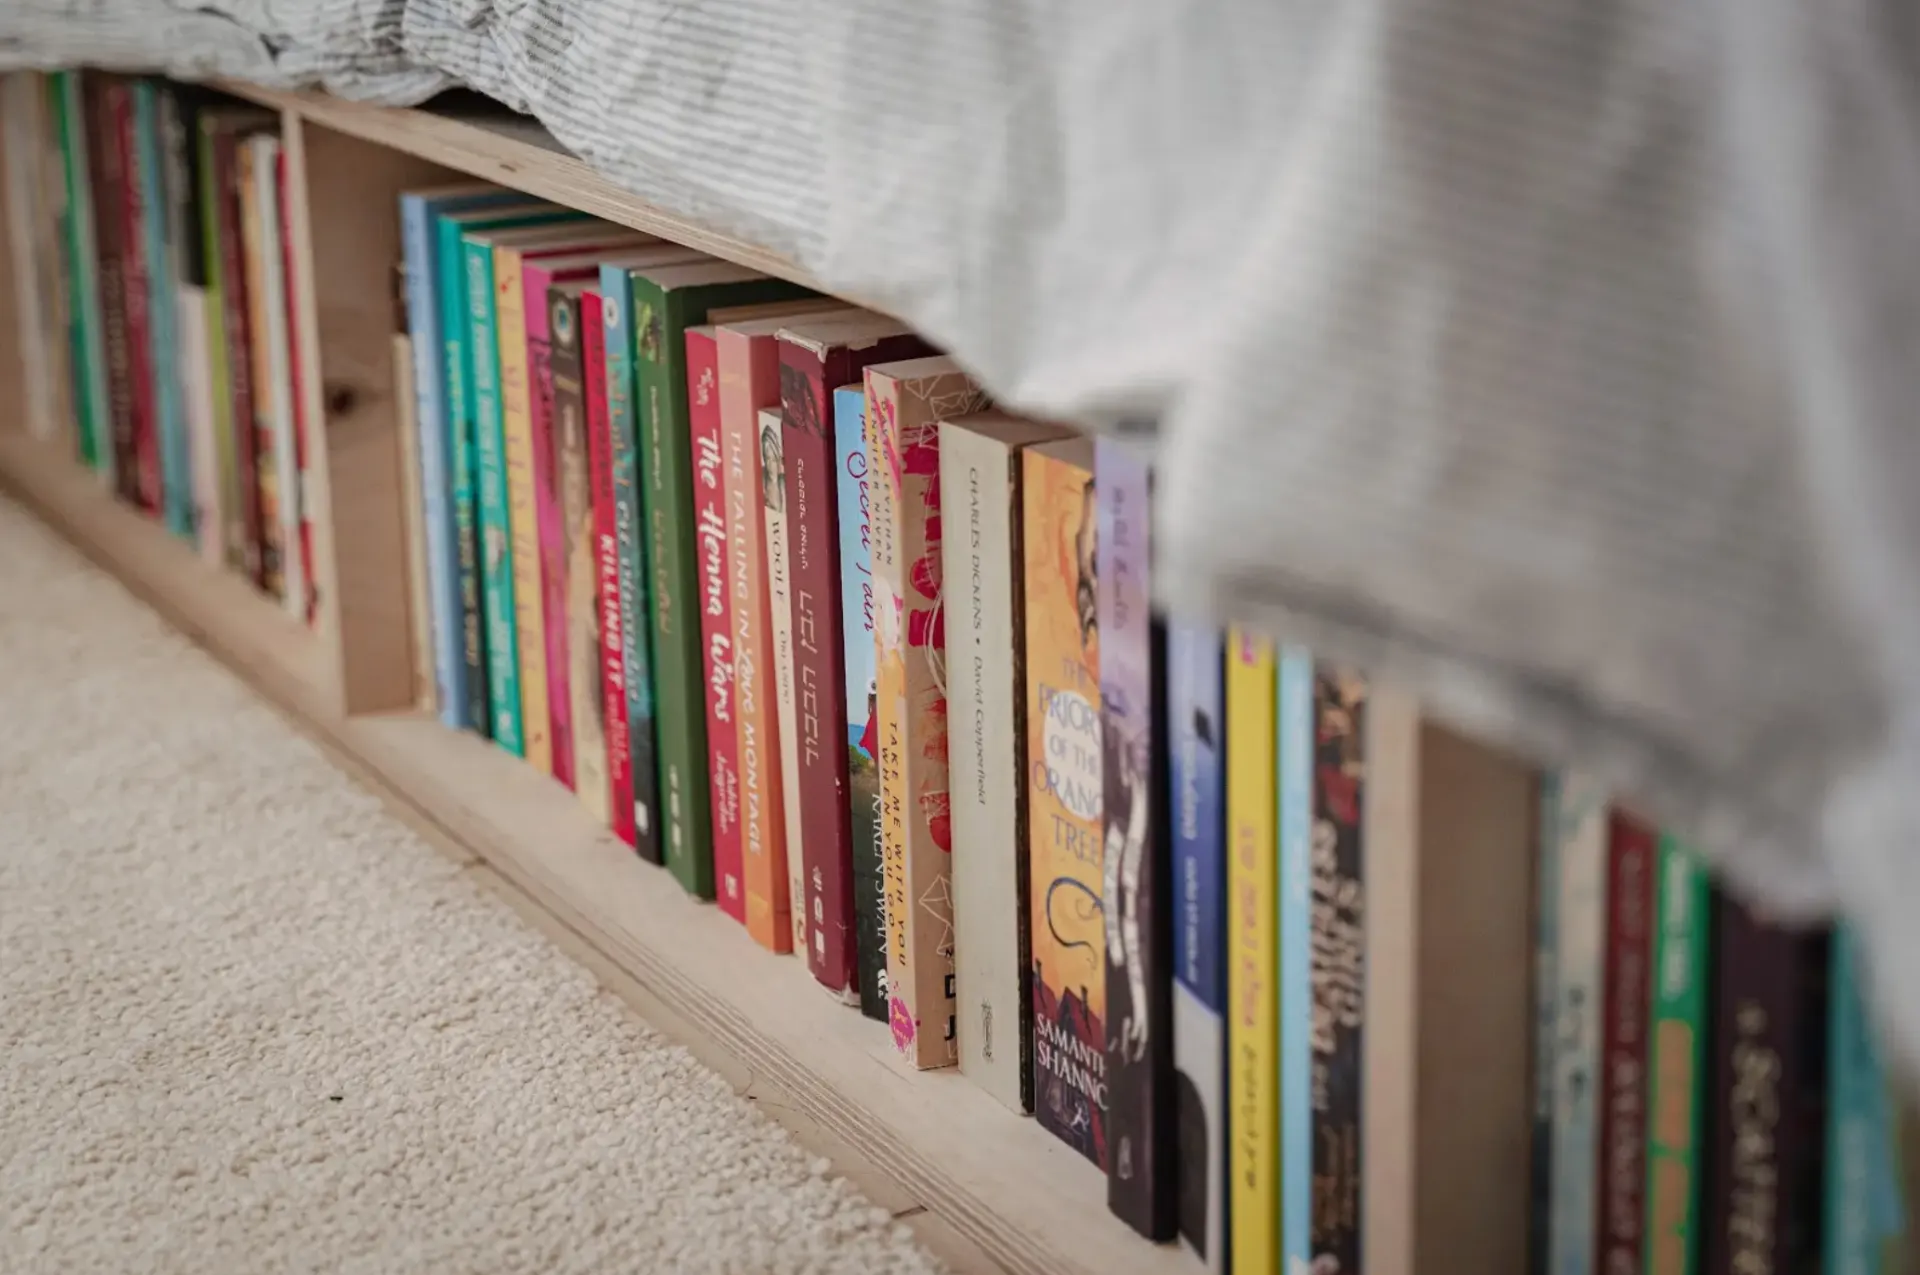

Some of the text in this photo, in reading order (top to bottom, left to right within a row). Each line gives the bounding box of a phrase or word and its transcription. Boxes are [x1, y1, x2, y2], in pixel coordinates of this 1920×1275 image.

[696, 427, 722, 489] The
[729, 431, 744, 480] THE
[869, 396, 882, 561] JENNIFER NIVEN
[700, 501, 727, 616] Henna
[732, 490, 748, 600] FALLING
[771, 520, 783, 603] WOOLF
[882, 471, 892, 565] LEVITHAN
[711, 632, 732, 722] Wars
[738, 609, 751, 638] IN
[798, 588, 819, 767] הבן הבכור
[968, 466, 987, 806] CHARLES DICKENS David Copperfield
[743, 721, 761, 854] MONTAGE
[881, 747, 895, 928] WHEN YOU GO
[889, 720, 906, 966] TAKE ME WITH YOU
